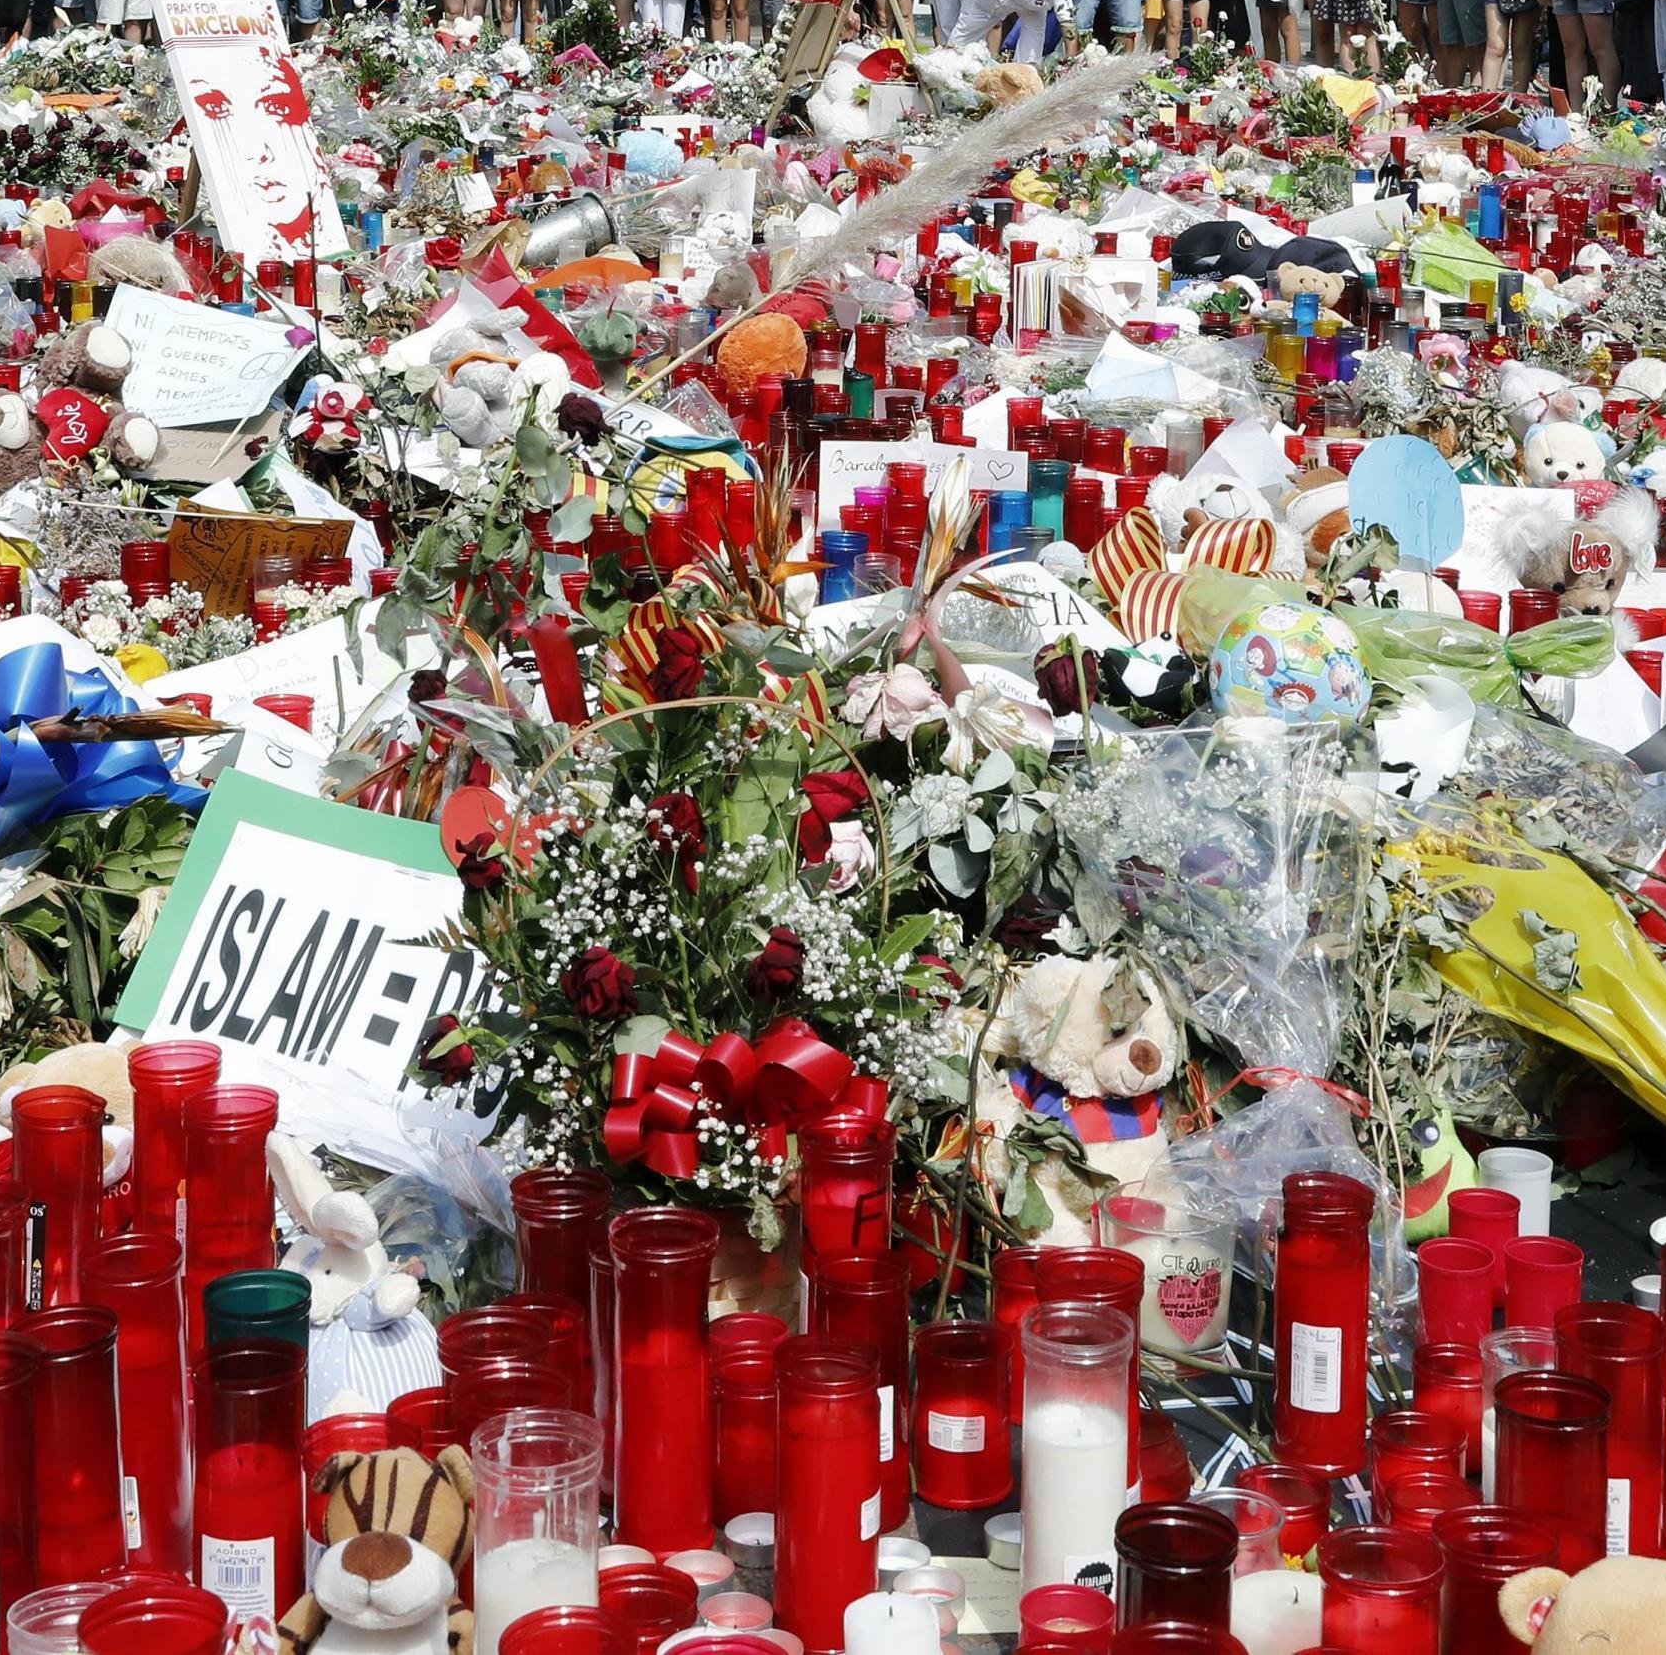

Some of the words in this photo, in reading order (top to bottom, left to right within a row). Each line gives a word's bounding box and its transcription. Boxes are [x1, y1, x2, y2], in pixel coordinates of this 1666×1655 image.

[166, 4, 194, 15] PRAY
[195, 3, 218, 14] FOR
[172, 14, 277, 36] BARCELONA
[60, 400, 90, 444] love
[1570, 531, 1612, 574] love
[170, 882, 386, 1066] ISLAM
